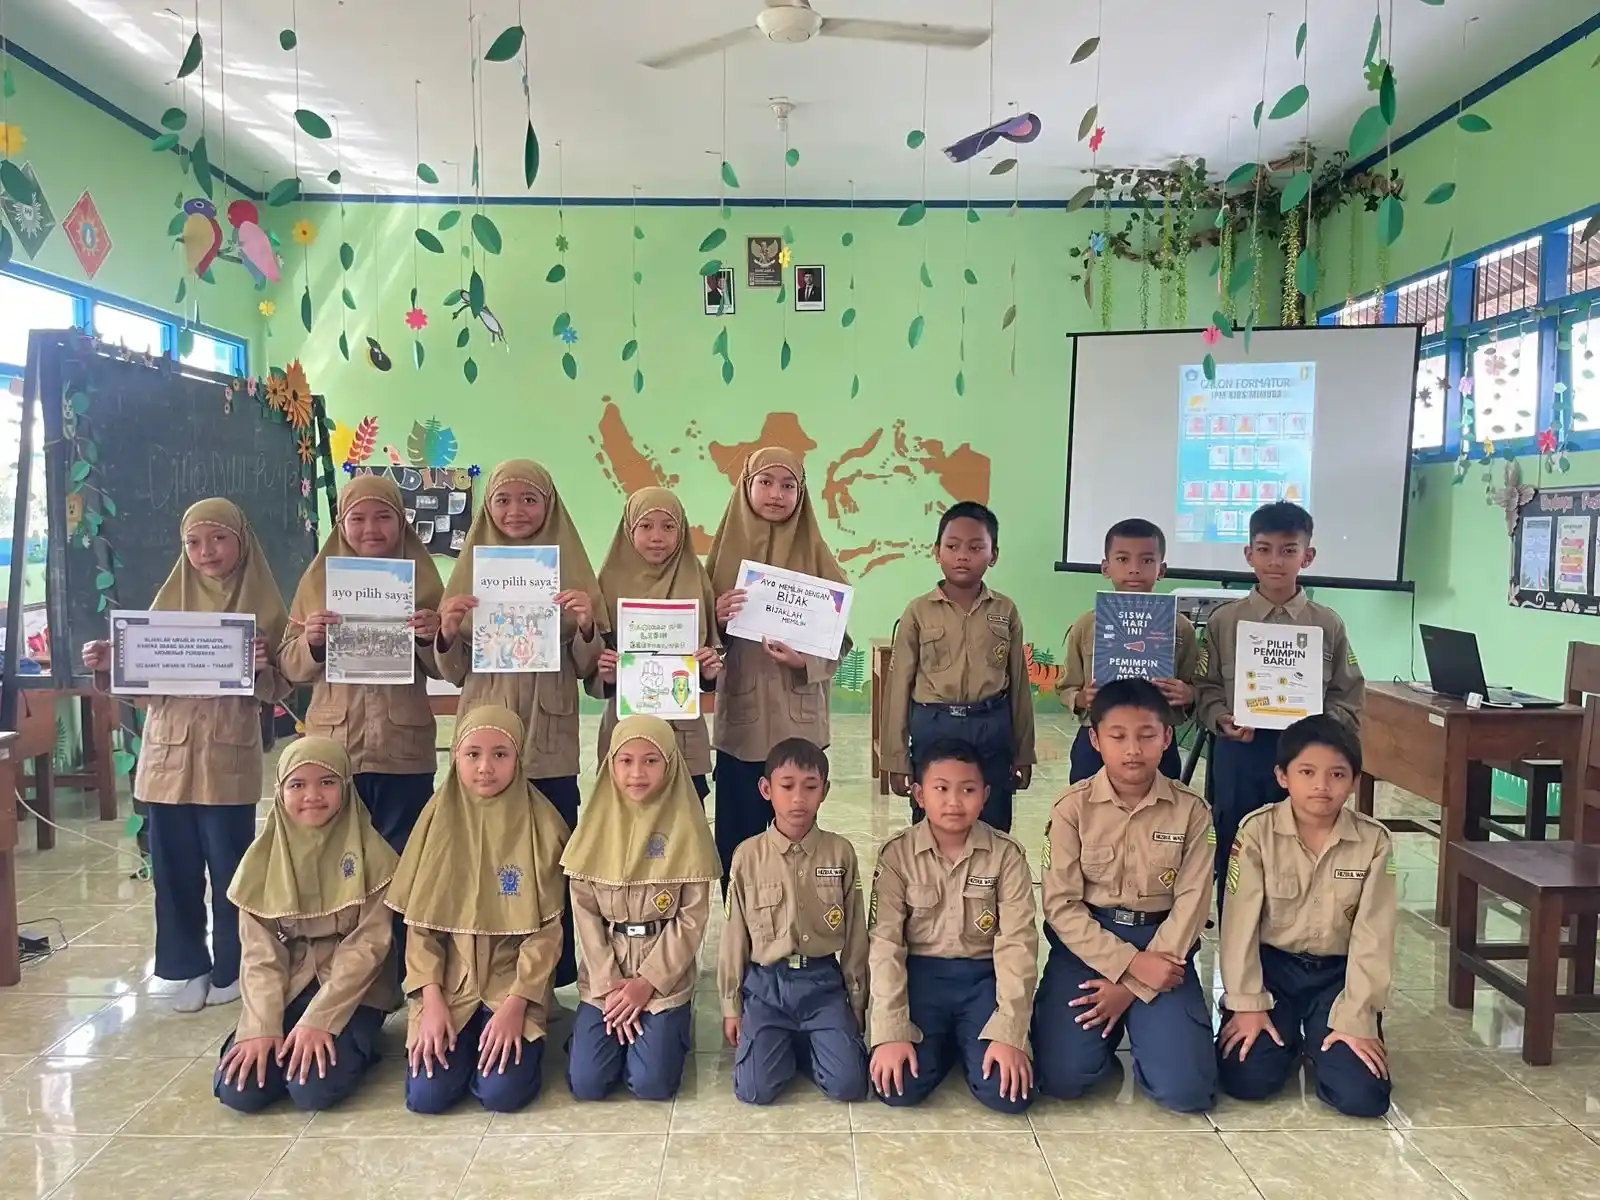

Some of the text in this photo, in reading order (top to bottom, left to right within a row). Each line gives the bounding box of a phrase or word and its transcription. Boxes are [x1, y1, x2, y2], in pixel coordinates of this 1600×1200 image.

[1235, 378, 1291, 389] FORMATUR
[480, 575, 552, 591] ayo pilih saya
[332, 587, 409, 602] ayo pilih saya
[760, 578, 830, 601] AYO MEMILIH DENGAN
[776, 591, 808, 607] BIJAK
[765, 604, 803, 619] BIJAKLAH
[1118, 611, 1153, 620] SISWA
[1122, 619, 1148, 628] HARI
[1127, 627, 1142, 636] INI
[1267, 640, 1293, 649] PILIH
[1253, 647, 1306, 659] PEMIMPIN
[1109, 657, 1158, 667] PEMIMPIN
[1263, 657, 1296, 667] BARU!
[1119, 667, 1148, 675] MASA
